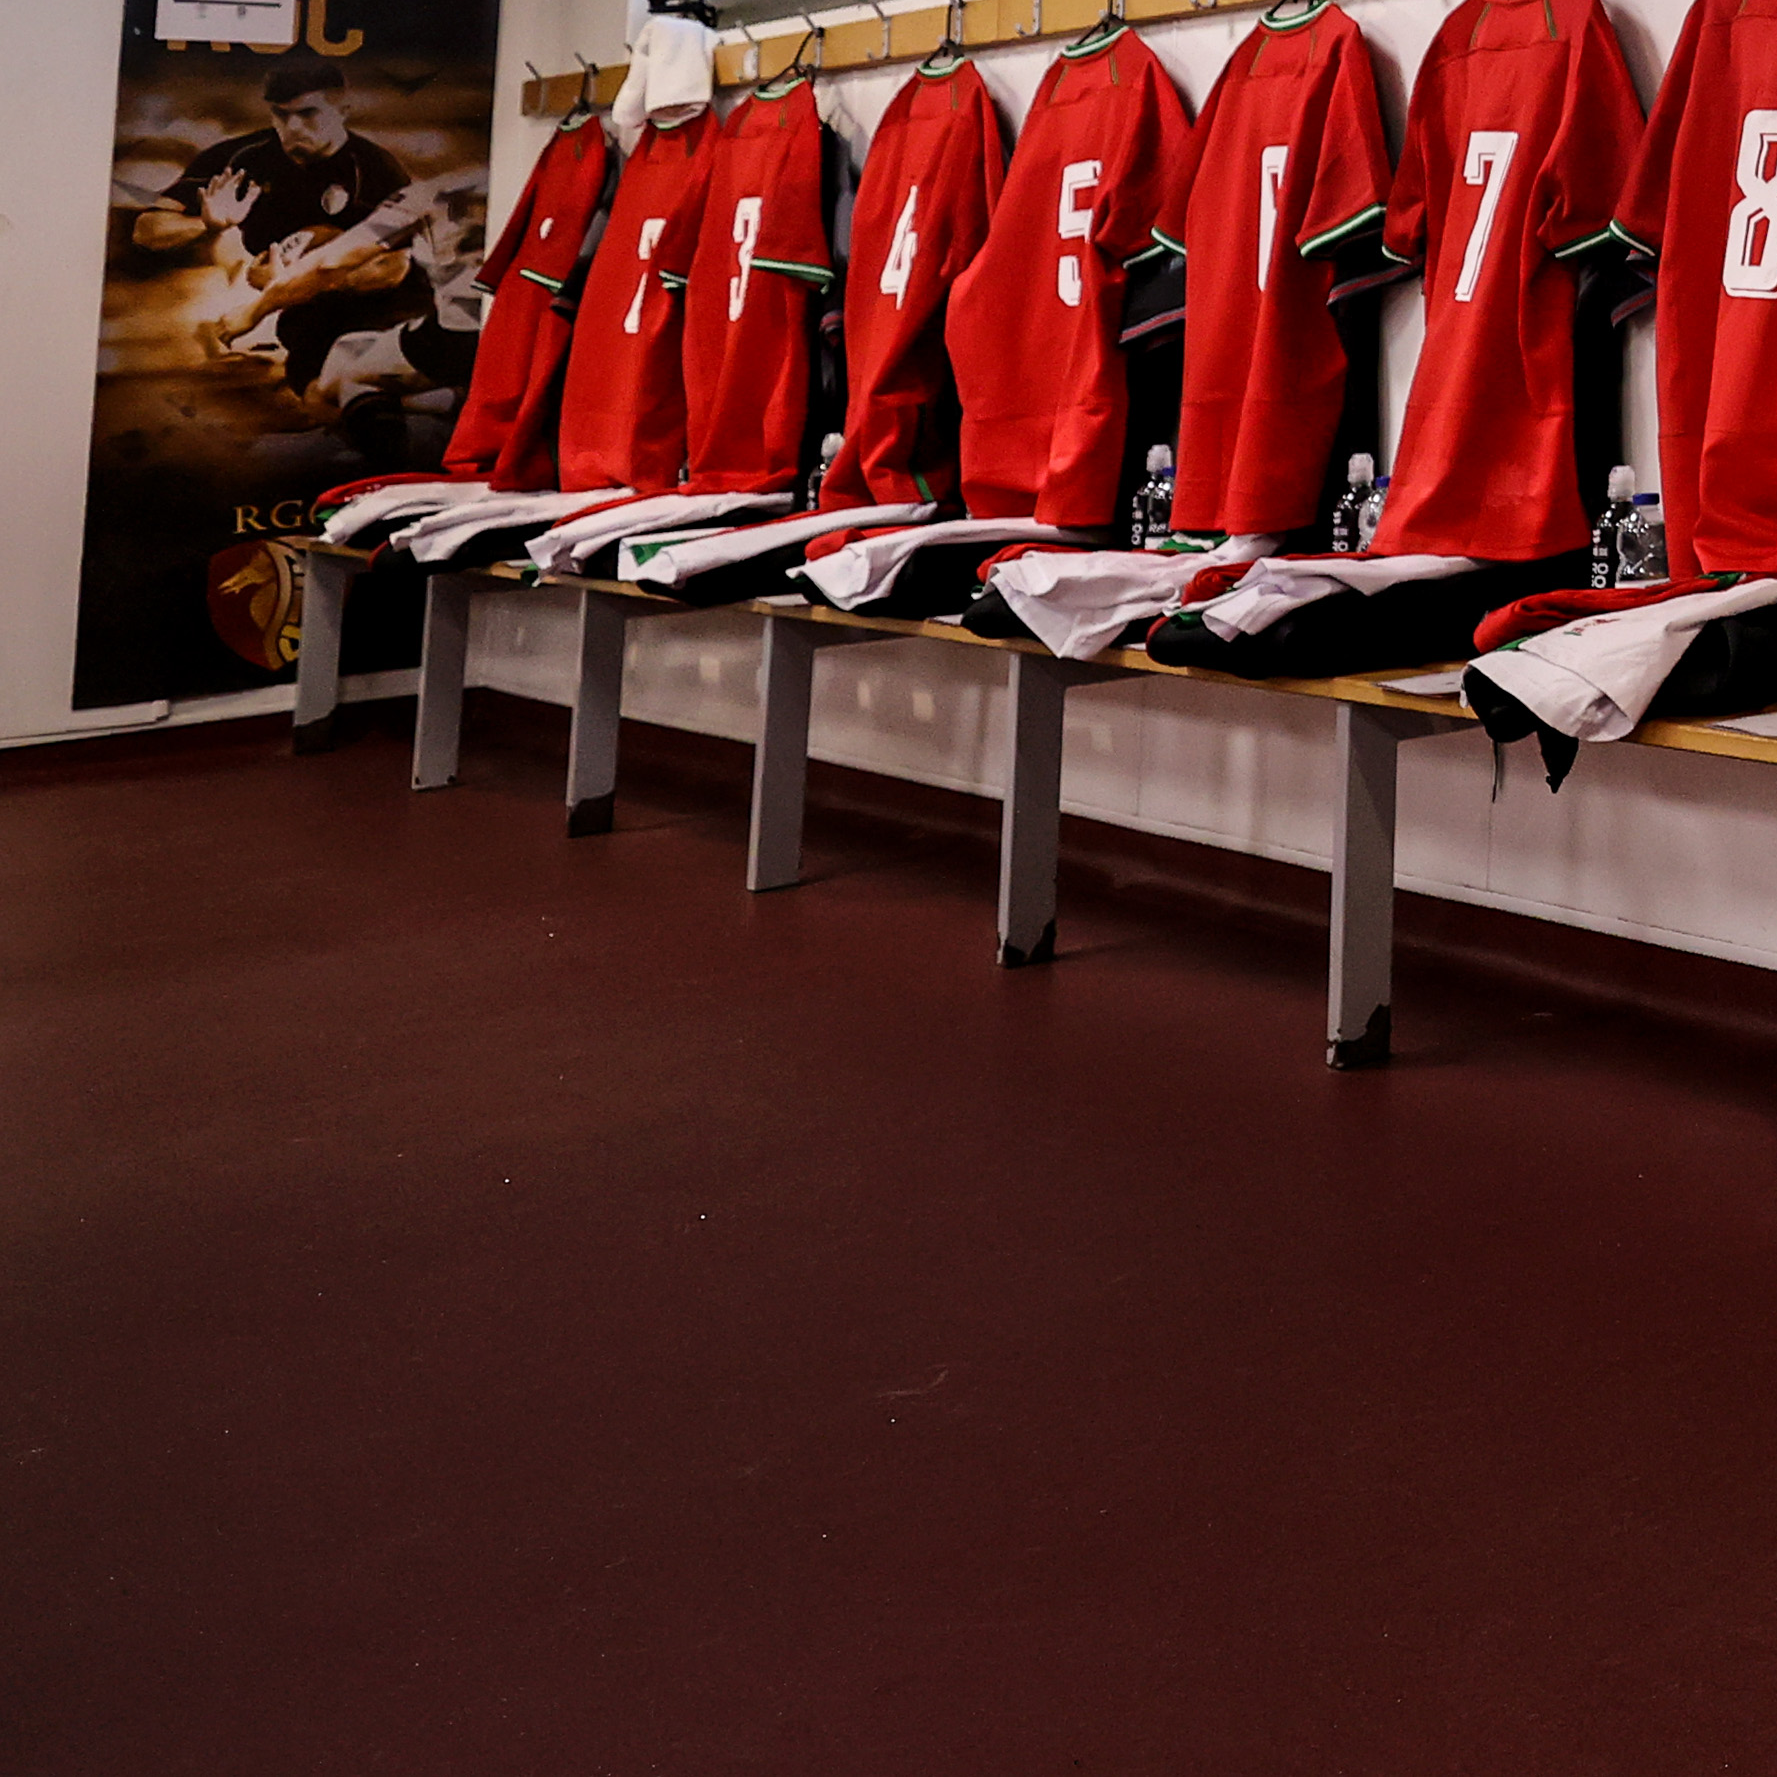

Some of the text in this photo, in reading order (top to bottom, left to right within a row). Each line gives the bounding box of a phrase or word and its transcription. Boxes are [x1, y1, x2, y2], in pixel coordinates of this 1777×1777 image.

[729, 196, 763, 322] 3
[880, 185, 918, 310] 4
[1058, 159, 1102, 307] 5
[1463, 131, 1519, 302] 7
[233, 499, 318, 534] RG
